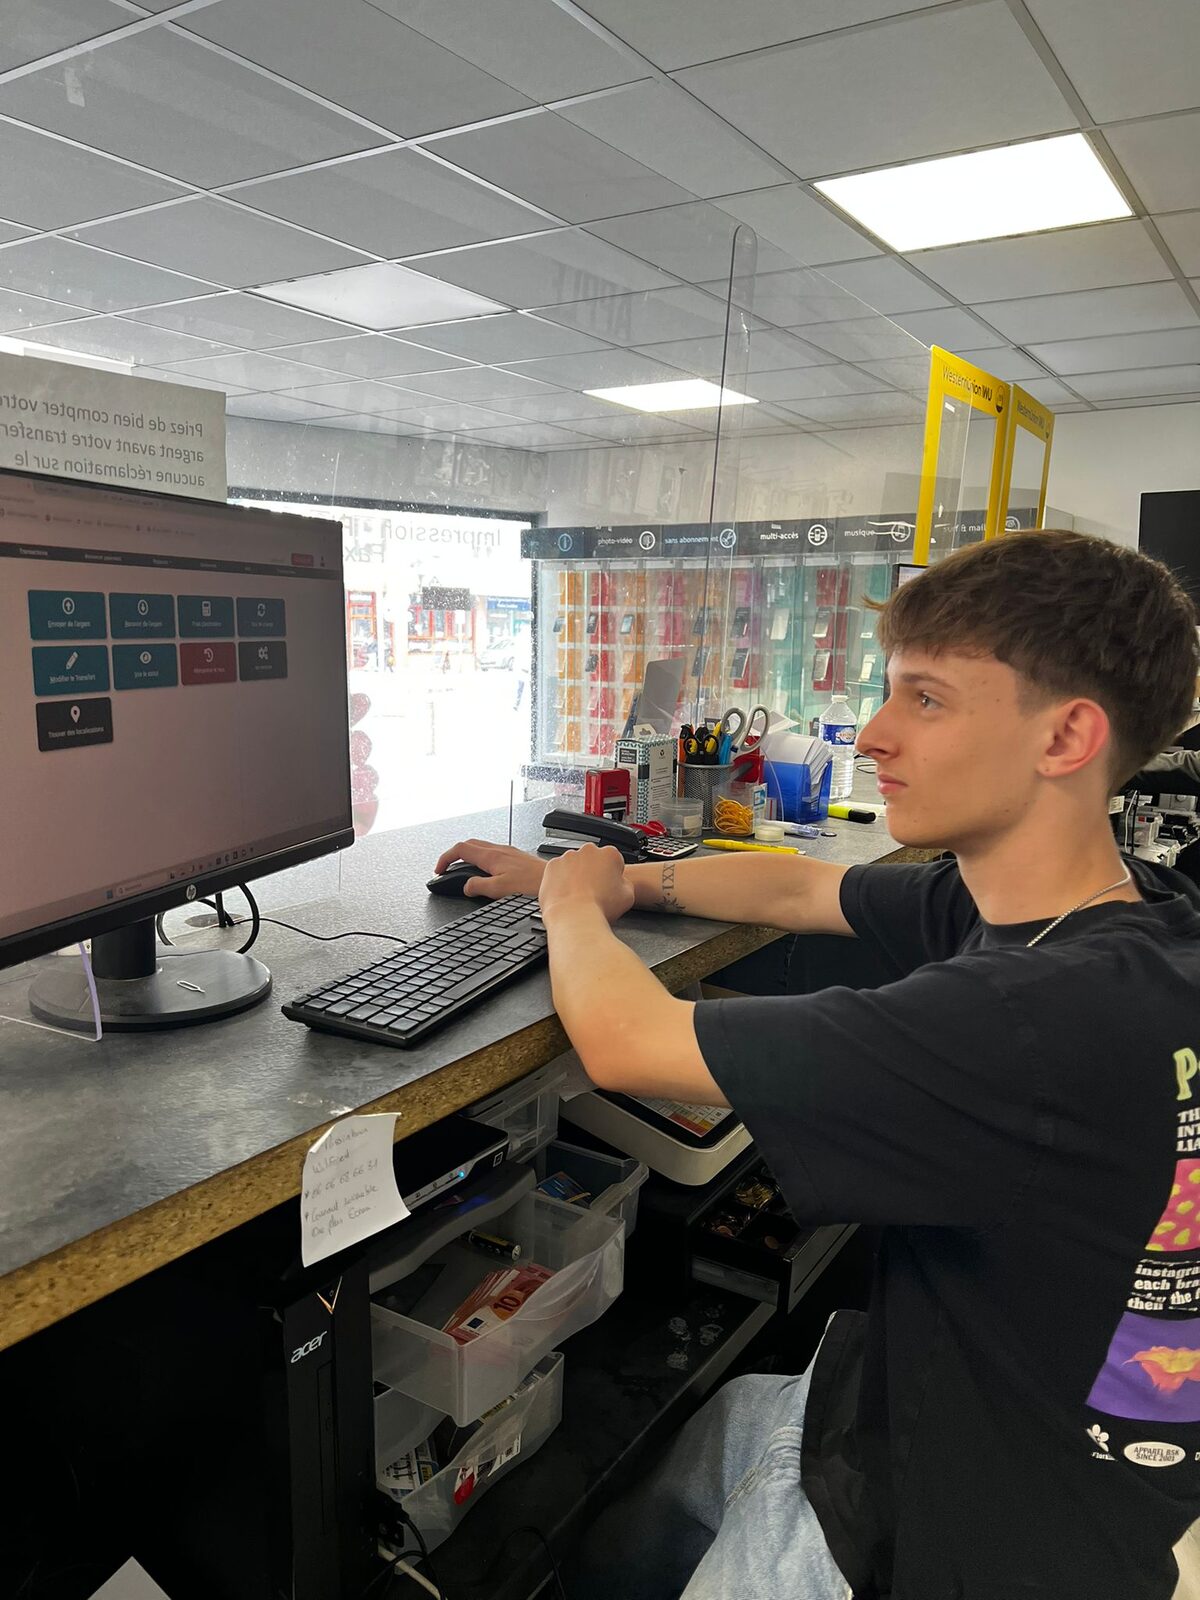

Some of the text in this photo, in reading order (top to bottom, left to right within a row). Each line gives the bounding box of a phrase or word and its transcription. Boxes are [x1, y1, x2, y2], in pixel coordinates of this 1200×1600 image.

[760, 532, 799, 540] multi-accès
[844, 528, 875, 537] musique
[1133, 1279, 1171, 1290] each
[1170, 1291, 1192, 1305] the
[493, 1295, 522, 1313] 10
[290, 1331, 328, 1364] acer
[1133, 1447, 1163, 1457] APPAREL
